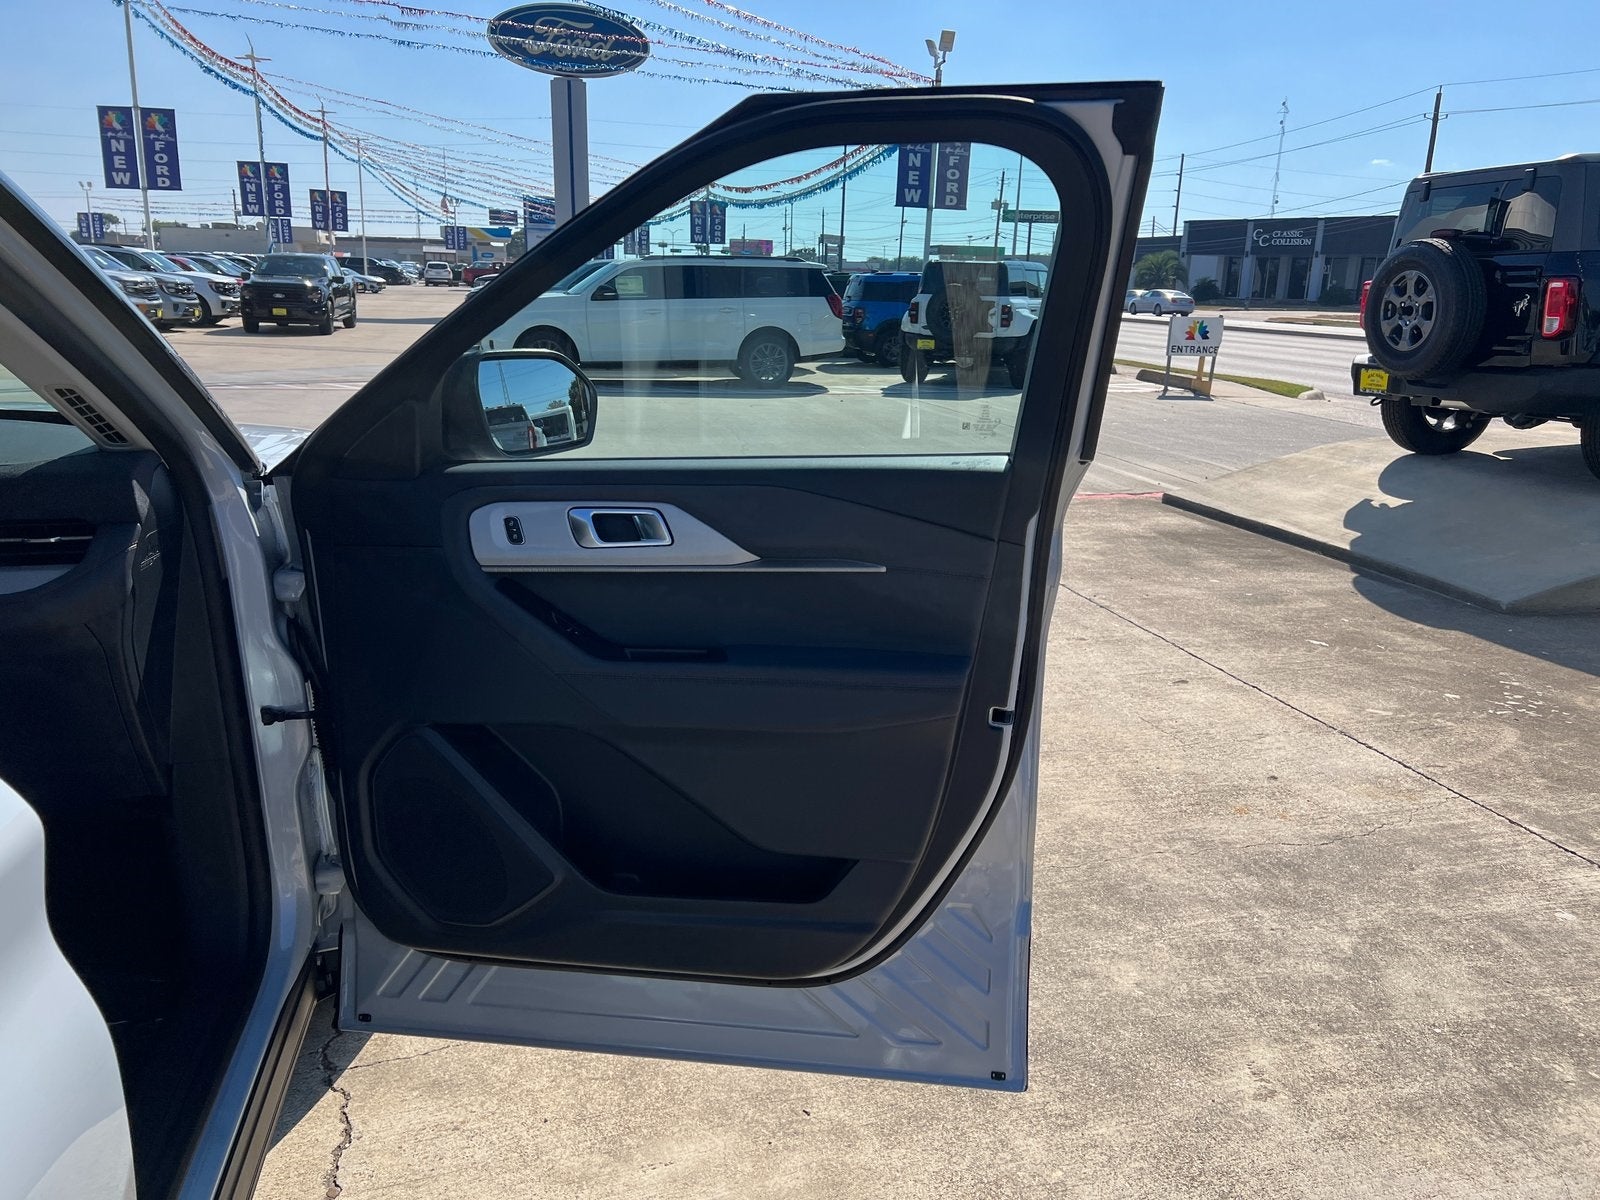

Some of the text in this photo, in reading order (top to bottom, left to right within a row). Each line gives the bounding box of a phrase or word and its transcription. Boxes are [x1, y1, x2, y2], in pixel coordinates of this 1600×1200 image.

[525, 16, 616, 62] Ford
[111, 139, 131, 185] NEW
[154, 141, 171, 187] FORD
[904, 153, 922, 203] NEW
[945, 155, 960, 206] FORD
[246, 183, 259, 213] NEW
[273, 184, 285, 215] FORD
[315, 205, 325, 229] NEW
[335, 206, 344, 230] FORD
[694, 218, 703, 242] NEW
[714, 219, 722, 243] FORD
[1271, 238, 1313, 246] COLLISION
[1272, 230, 1304, 238] CLASSIC
[1170, 345, 1220, 354] ENTRANCE
